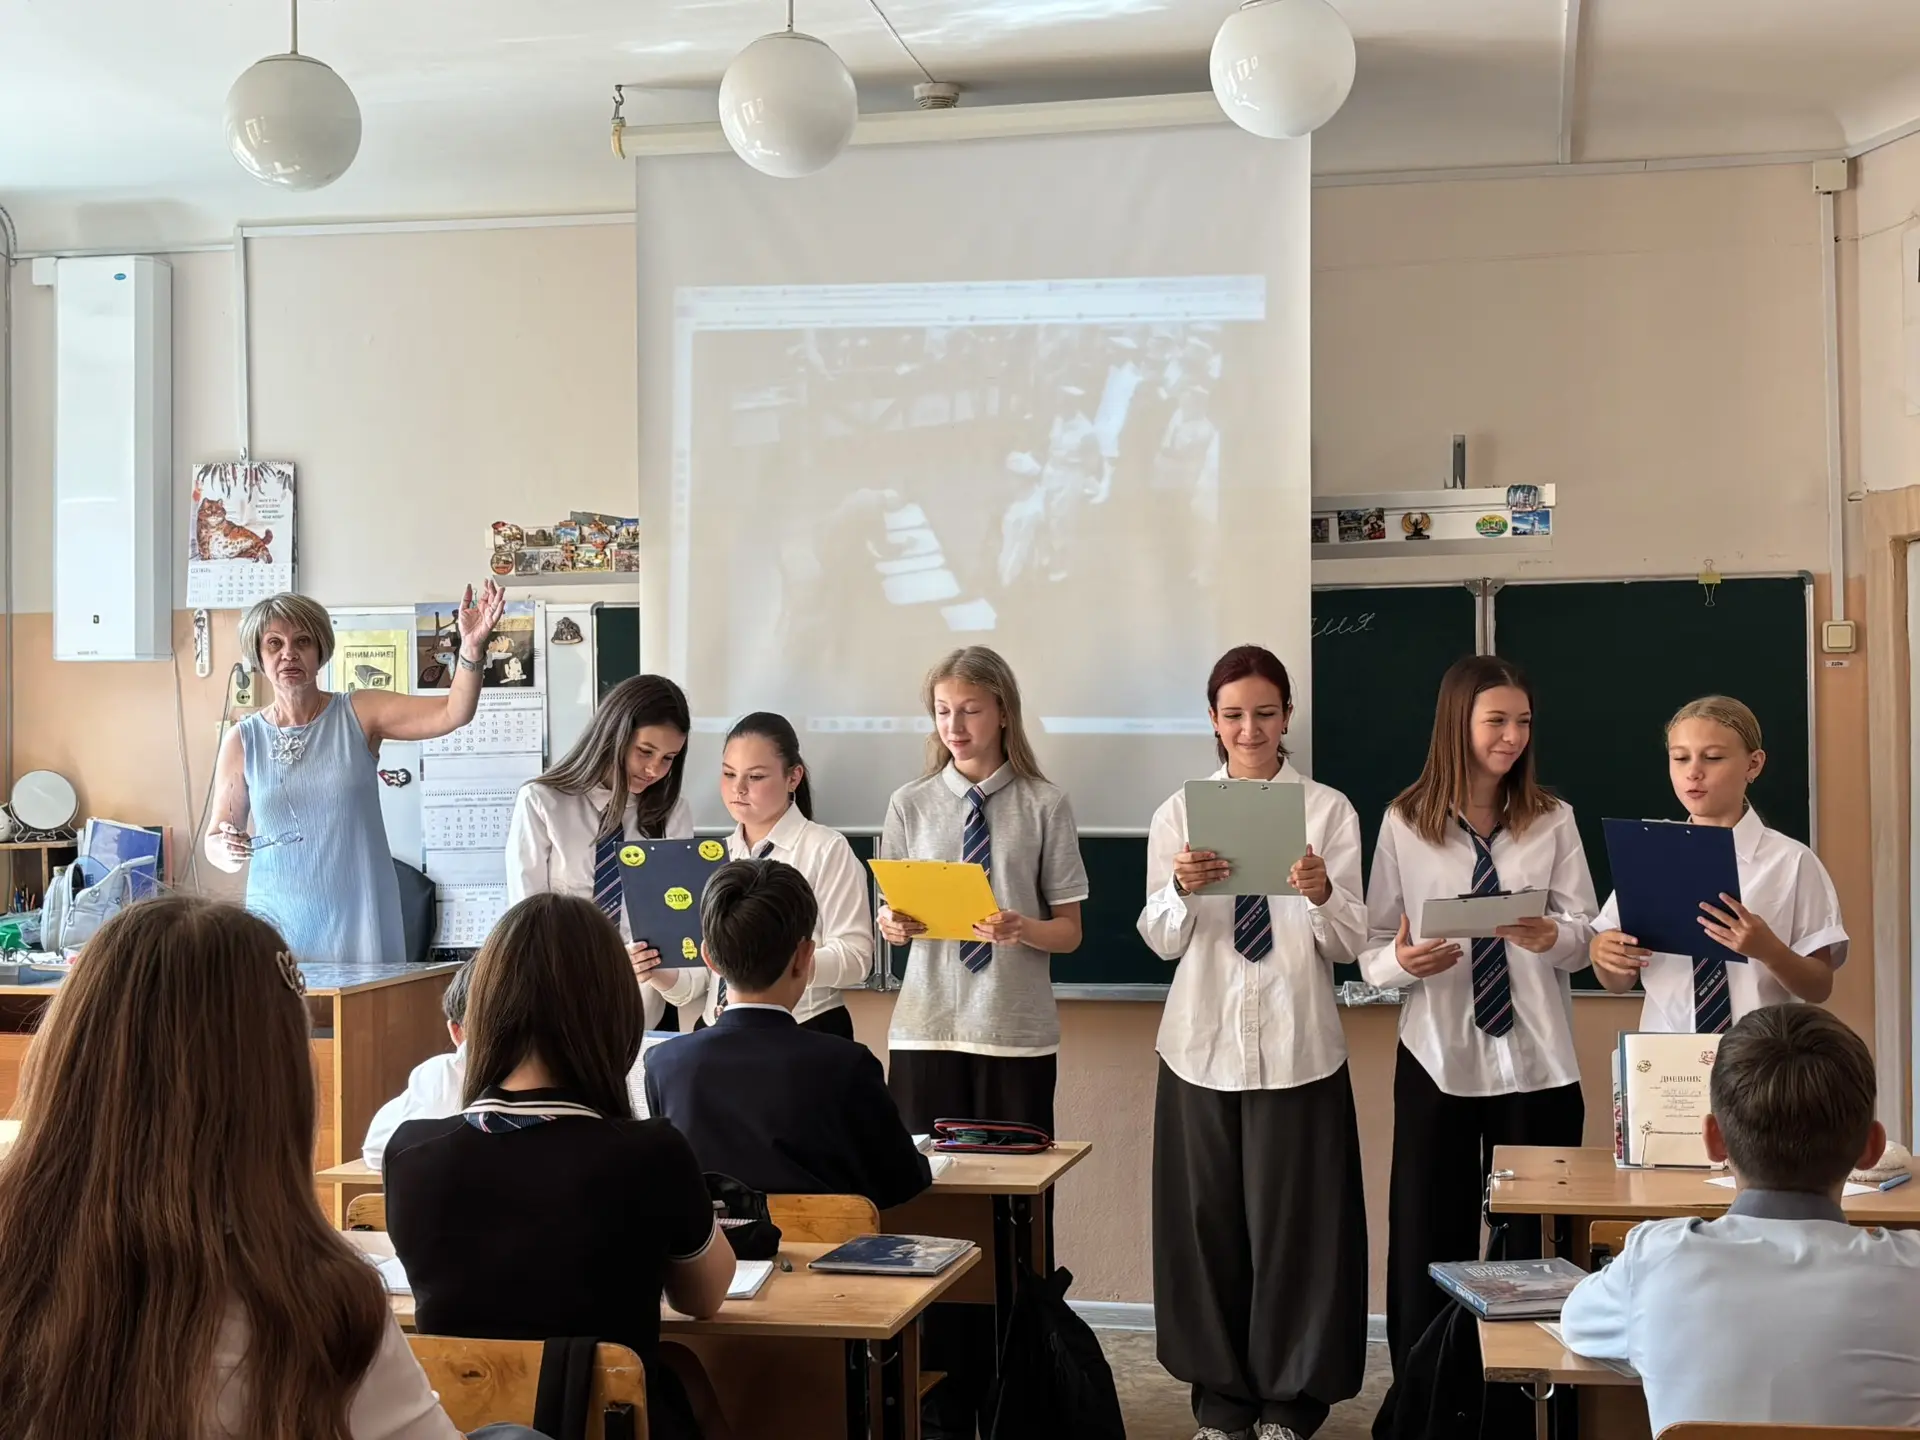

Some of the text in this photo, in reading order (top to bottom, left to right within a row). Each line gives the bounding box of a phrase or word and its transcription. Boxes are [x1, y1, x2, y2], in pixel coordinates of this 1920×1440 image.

[346, 651, 394, 659] ВНИМАНИЕ!
[667, 893, 689, 903] STOP
[1660, 1075, 1702, 1083] ДНЕВНИК
